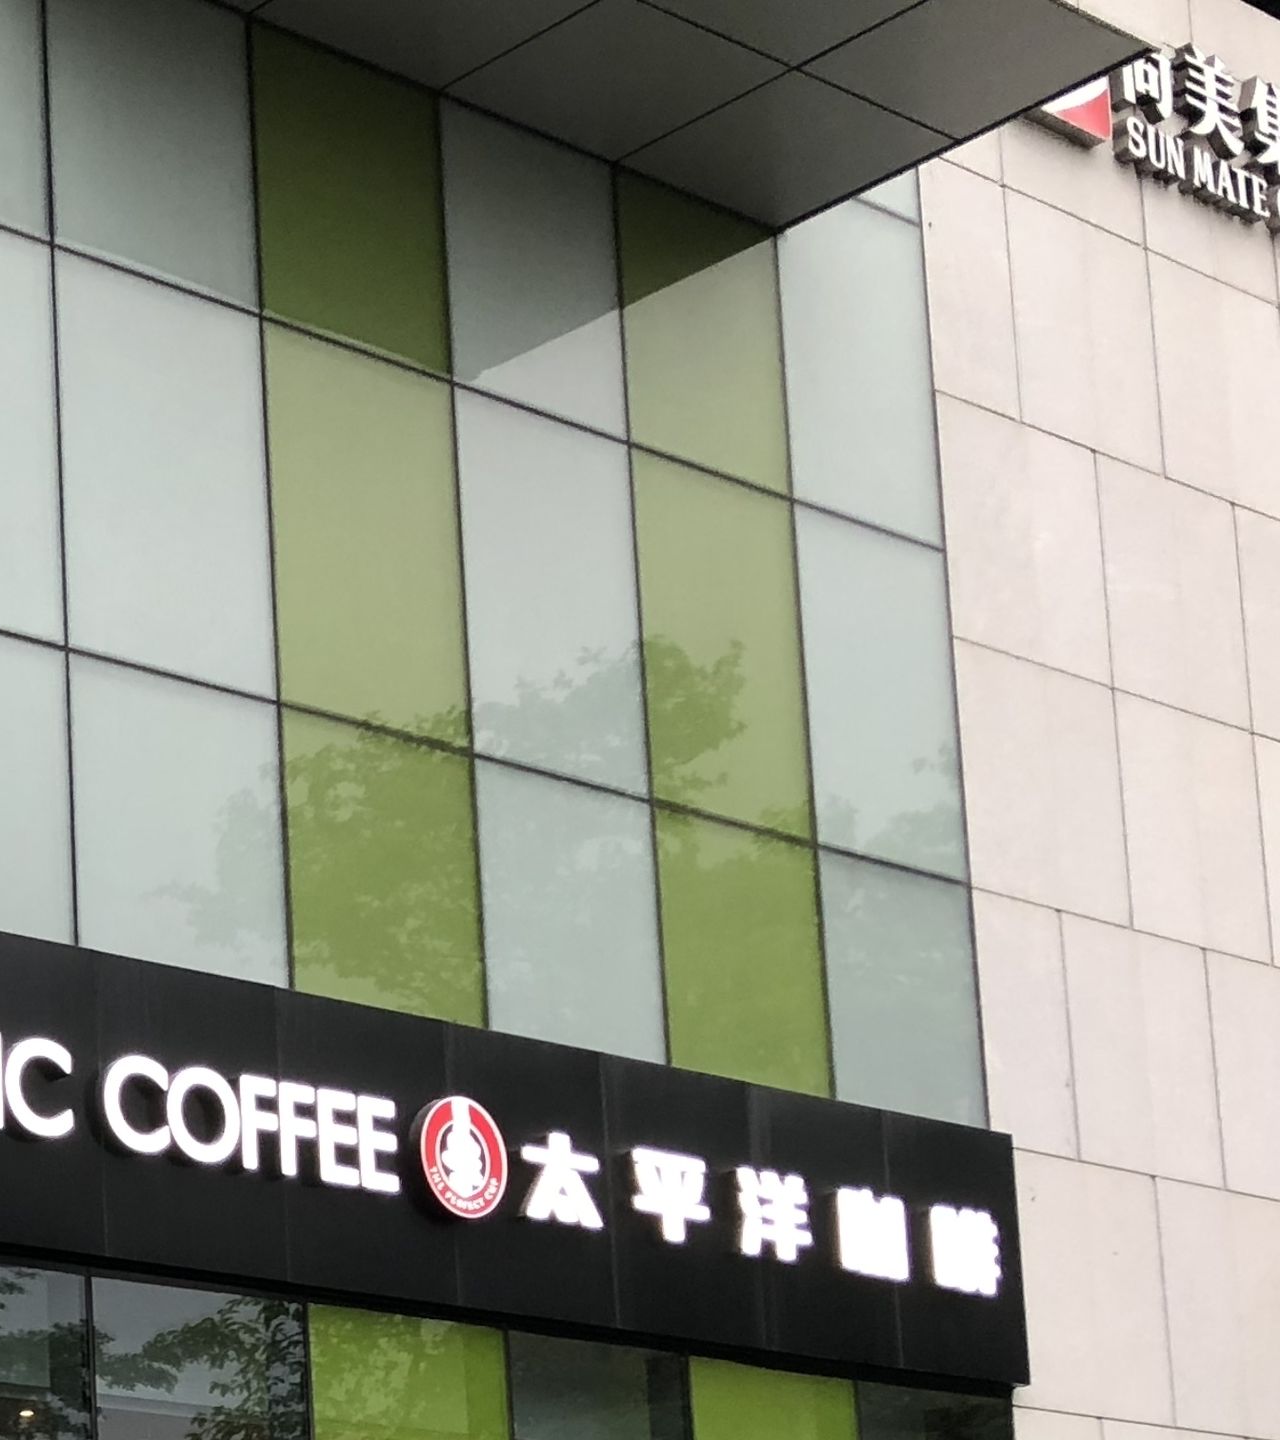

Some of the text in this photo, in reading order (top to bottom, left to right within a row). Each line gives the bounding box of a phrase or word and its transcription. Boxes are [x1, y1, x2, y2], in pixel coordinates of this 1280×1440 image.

[1127, 116, 1270, 217] SUN MATE
[103, 1053, 399, 1193] COFFEE
